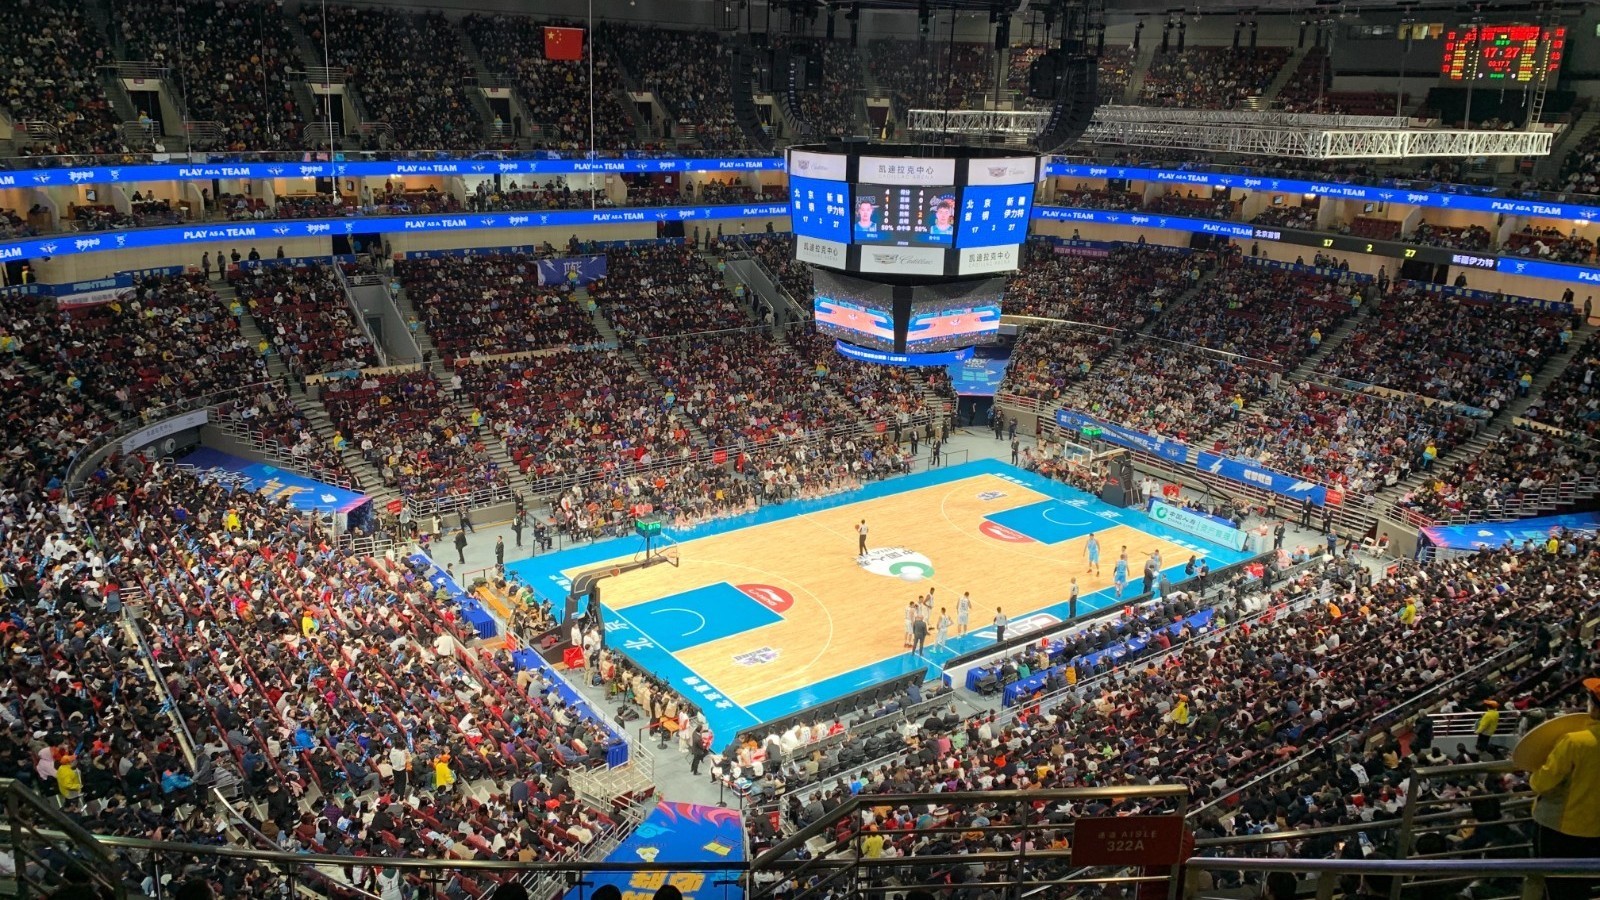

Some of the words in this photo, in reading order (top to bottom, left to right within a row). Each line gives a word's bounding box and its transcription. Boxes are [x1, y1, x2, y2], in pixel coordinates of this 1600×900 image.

[1484, 47, 1498, 58] 17
[1504, 47, 1520, 58] 27
[180, 168, 203, 177] PLAY
[222, 167, 250, 176] TEAM
[433, 164, 457, 172] TEAM
[879, 165, 934, 175] 凯迪拉克中心
[1311, 185, 1329, 193] PLAY
[1343, 188, 1365, 196] TEAM
[966, 198, 991, 209] 北京
[1491, 202, 1515, 210] PLAY
[1532, 205, 1561, 215] TEAM
[623, 212, 644, 220] TEAM
[1003, 208, 1024, 219] 伊力特
[405, 220, 426, 228] PLAY
[442, 219, 467, 227] TEAM
[1008, 223, 1015, 231] 27
[184, 230, 208, 239] PLAY
[226, 228, 256, 237] TEAM
[971, 226, 979, 234] 17
[1232, 227, 1252, 236] TEAM
[1323, 239, 1333, 247] 17
[1366, 244, 1373, 252] 2
[1404, 249, 1416, 257] 27
[1579, 271, 1600, 281] PLA
[1121, 831, 1158, 839] AISLE
[1106, 840, 1144, 852] 322A
